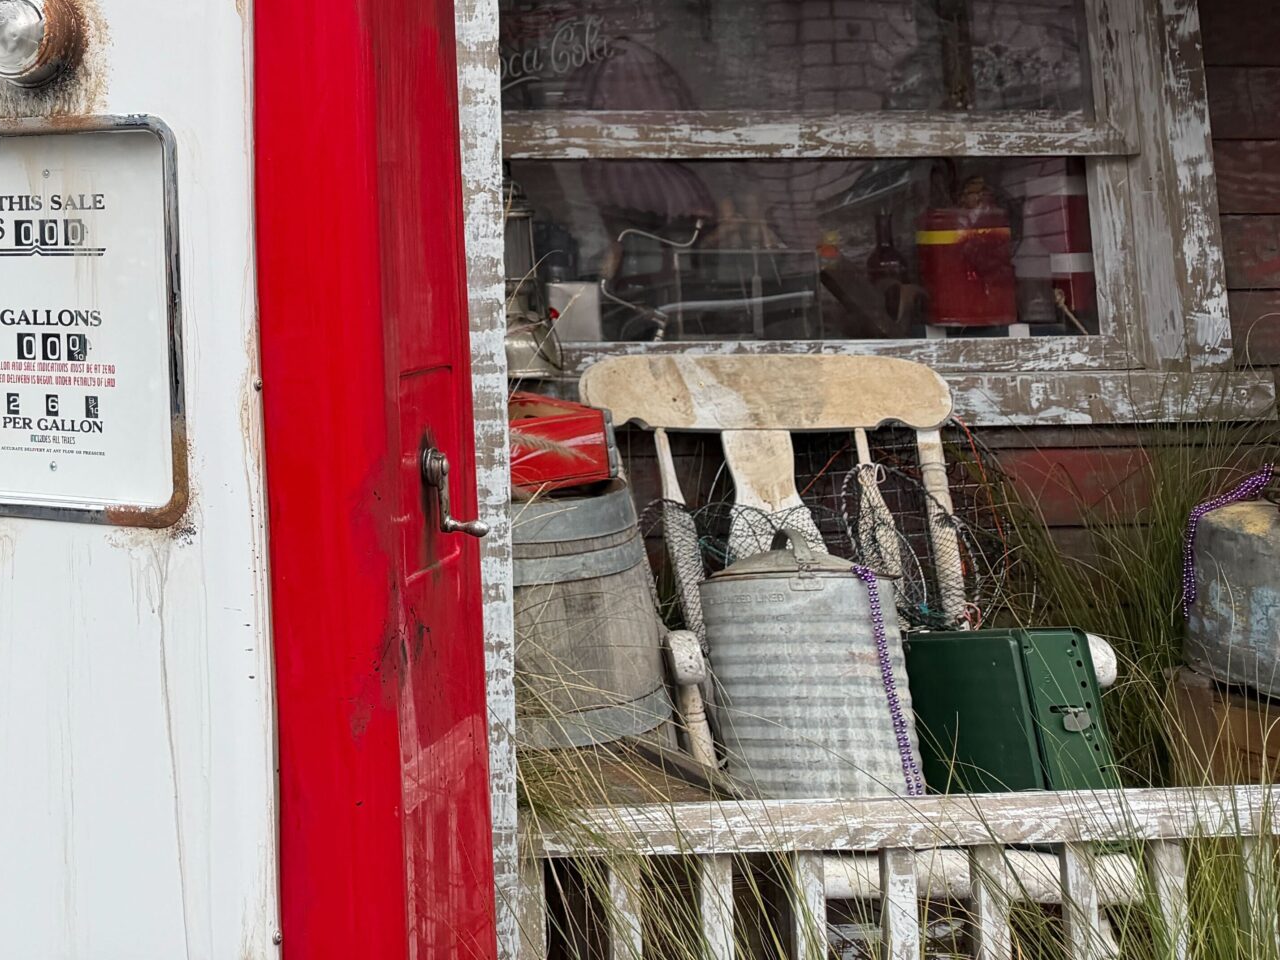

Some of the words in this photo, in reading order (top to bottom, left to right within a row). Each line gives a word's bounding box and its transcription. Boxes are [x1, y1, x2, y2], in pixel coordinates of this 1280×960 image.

[50, 194, 105, 210] SALE
[0, 309, 102, 327] GALLONS
[3, 416, 33, 430] PER
[37, 418, 103, 434] GALLON
